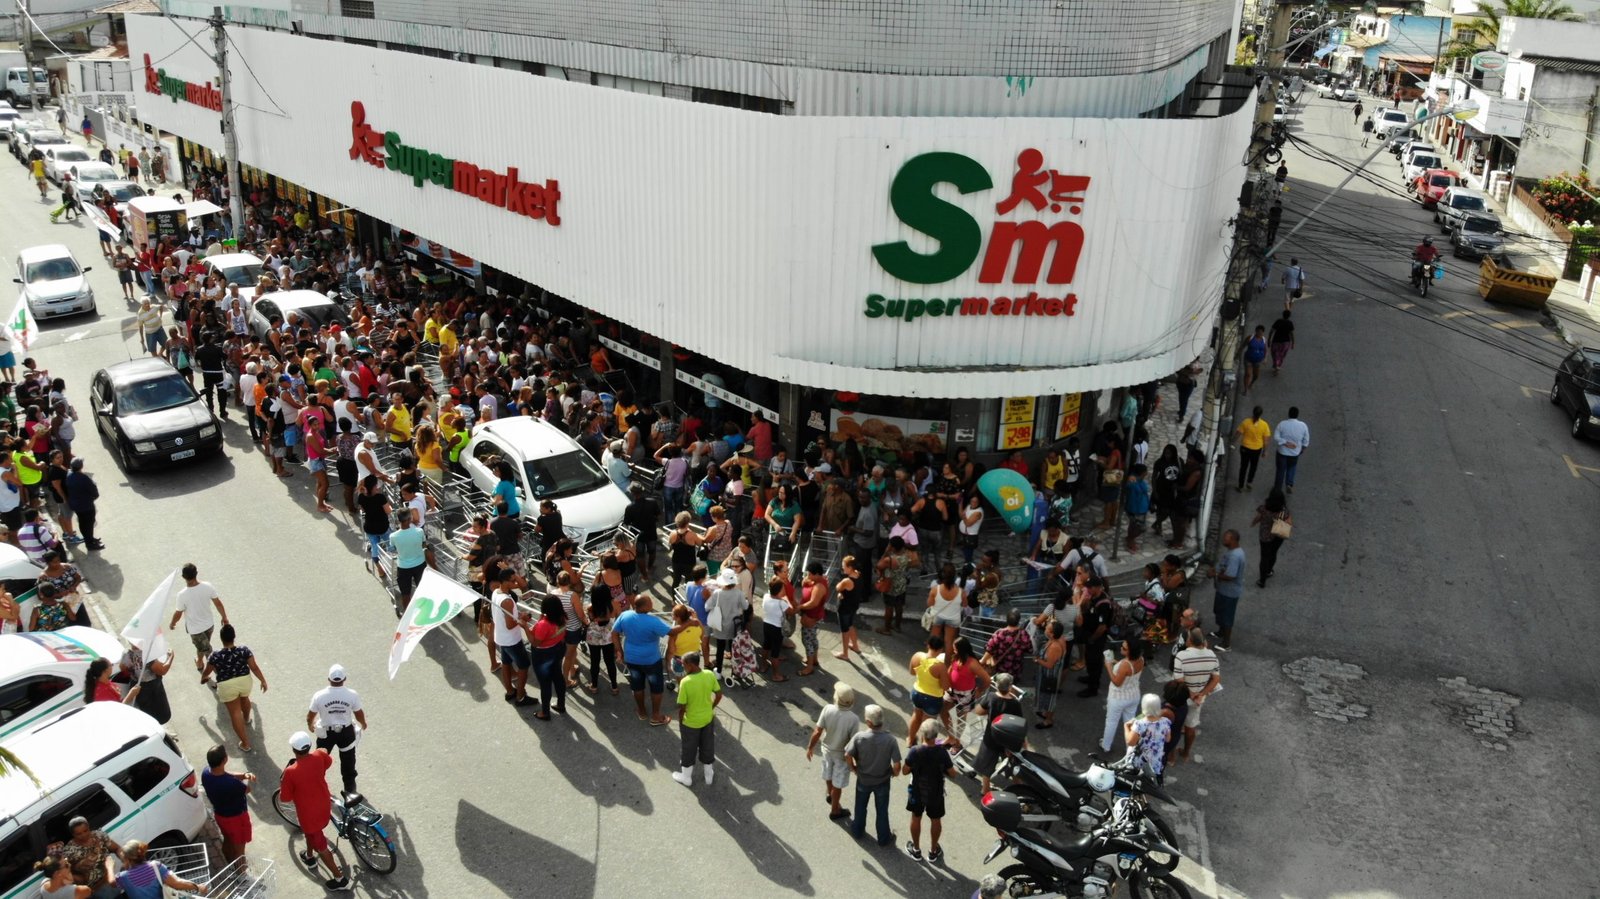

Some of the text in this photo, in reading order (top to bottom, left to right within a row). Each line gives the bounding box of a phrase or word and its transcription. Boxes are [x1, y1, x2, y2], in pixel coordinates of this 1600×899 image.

[158, 68, 222, 112] Supermarke
[384, 131, 561, 226] Supermarket
[864, 292, 1078, 322] Supermarket
[1006, 493, 1019, 506] oi
